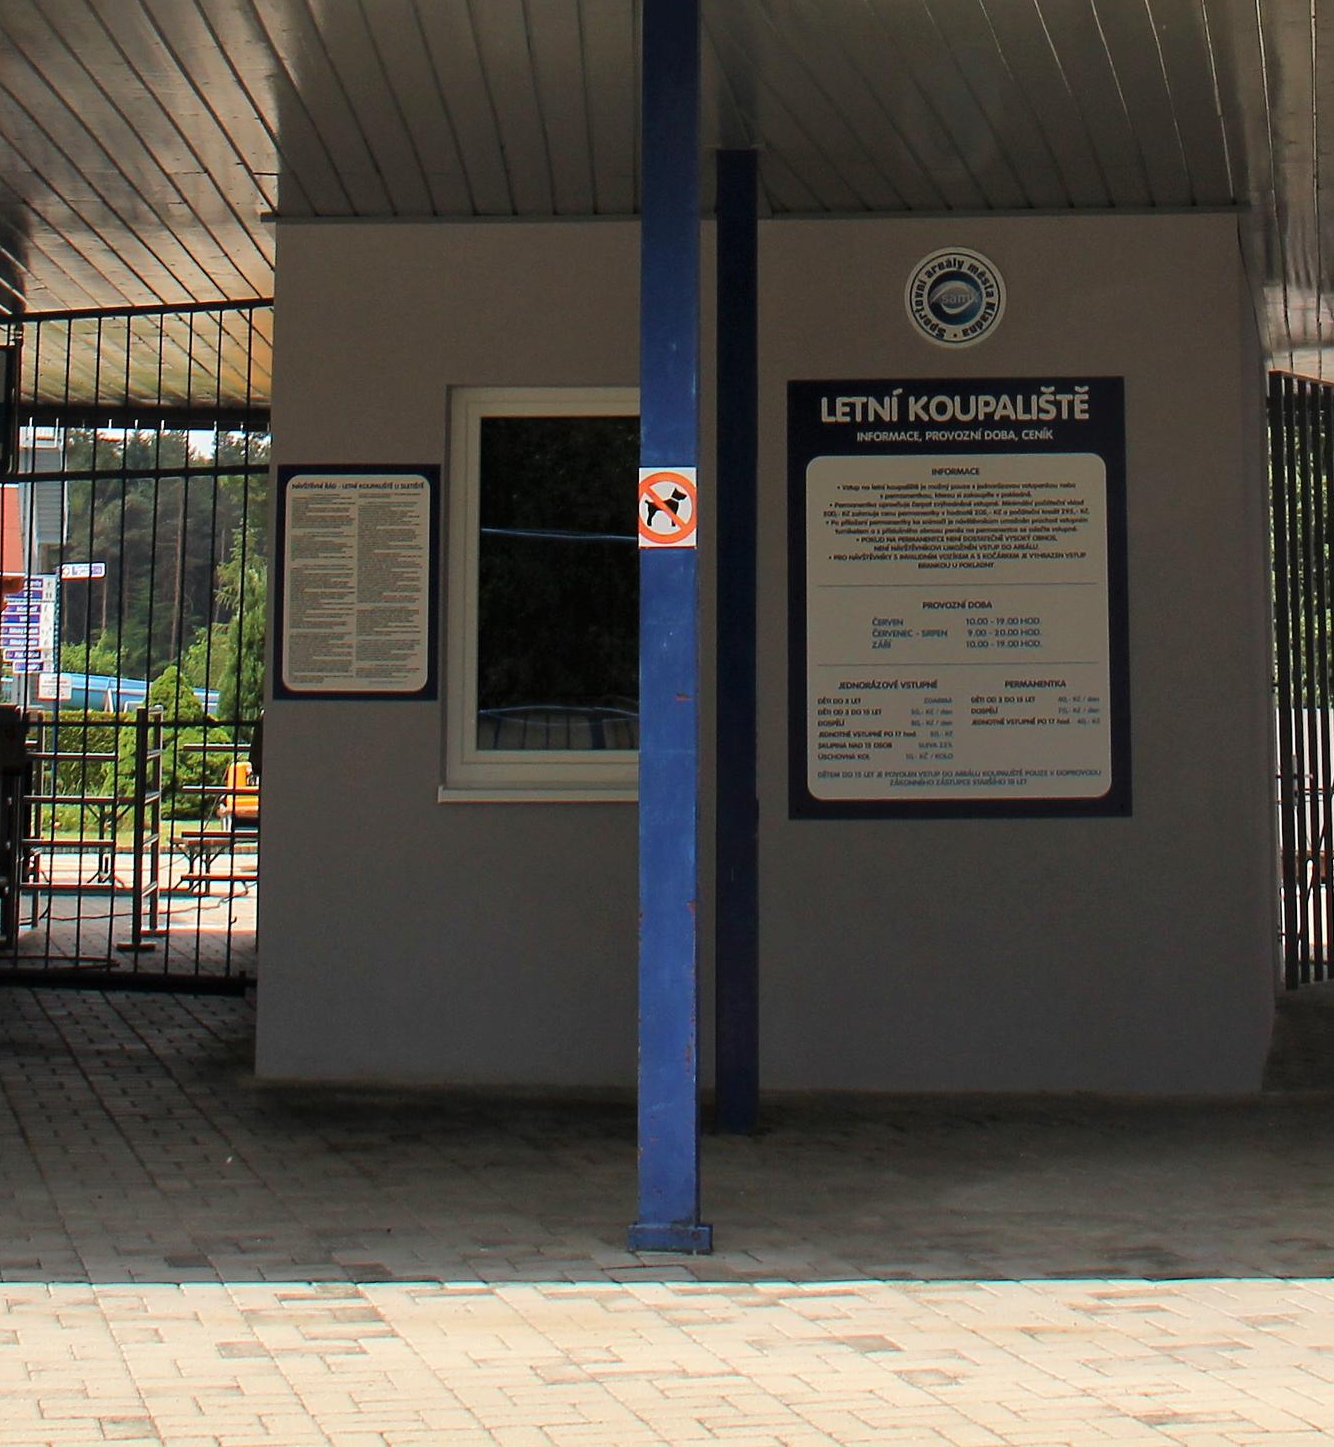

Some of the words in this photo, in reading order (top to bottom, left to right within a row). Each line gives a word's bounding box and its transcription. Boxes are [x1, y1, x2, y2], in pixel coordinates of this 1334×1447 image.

[821, 388, 903, 422] LETNÍ
[909, 385, 1090, 422] KOUPALIŠTĚ
[857, 430, 922, 443] INFORMACE,
[925, 428, 982, 441] PROVOZNÍ
[984, 430, 1018, 442] DOBA,
[1022, 427, 1054, 440] CENÍK
[932, 467, 980, 475] INFORMACE
[922, 600, 966, 609] PROVOZNÍ
[967, 601, 993, 609] DOBA
[871, 616, 904, 627] ČERVEN
[871, 628, 913, 638] ČERVENEC
[871, 639, 891, 649] ZÁŘÍ
[838, 680, 899, 690] JEDNORÁZOVÉ
[900, 680, 938, 689] VSTUPNÉ
[1005, 680, 1067, 688] PERMANENTKA
